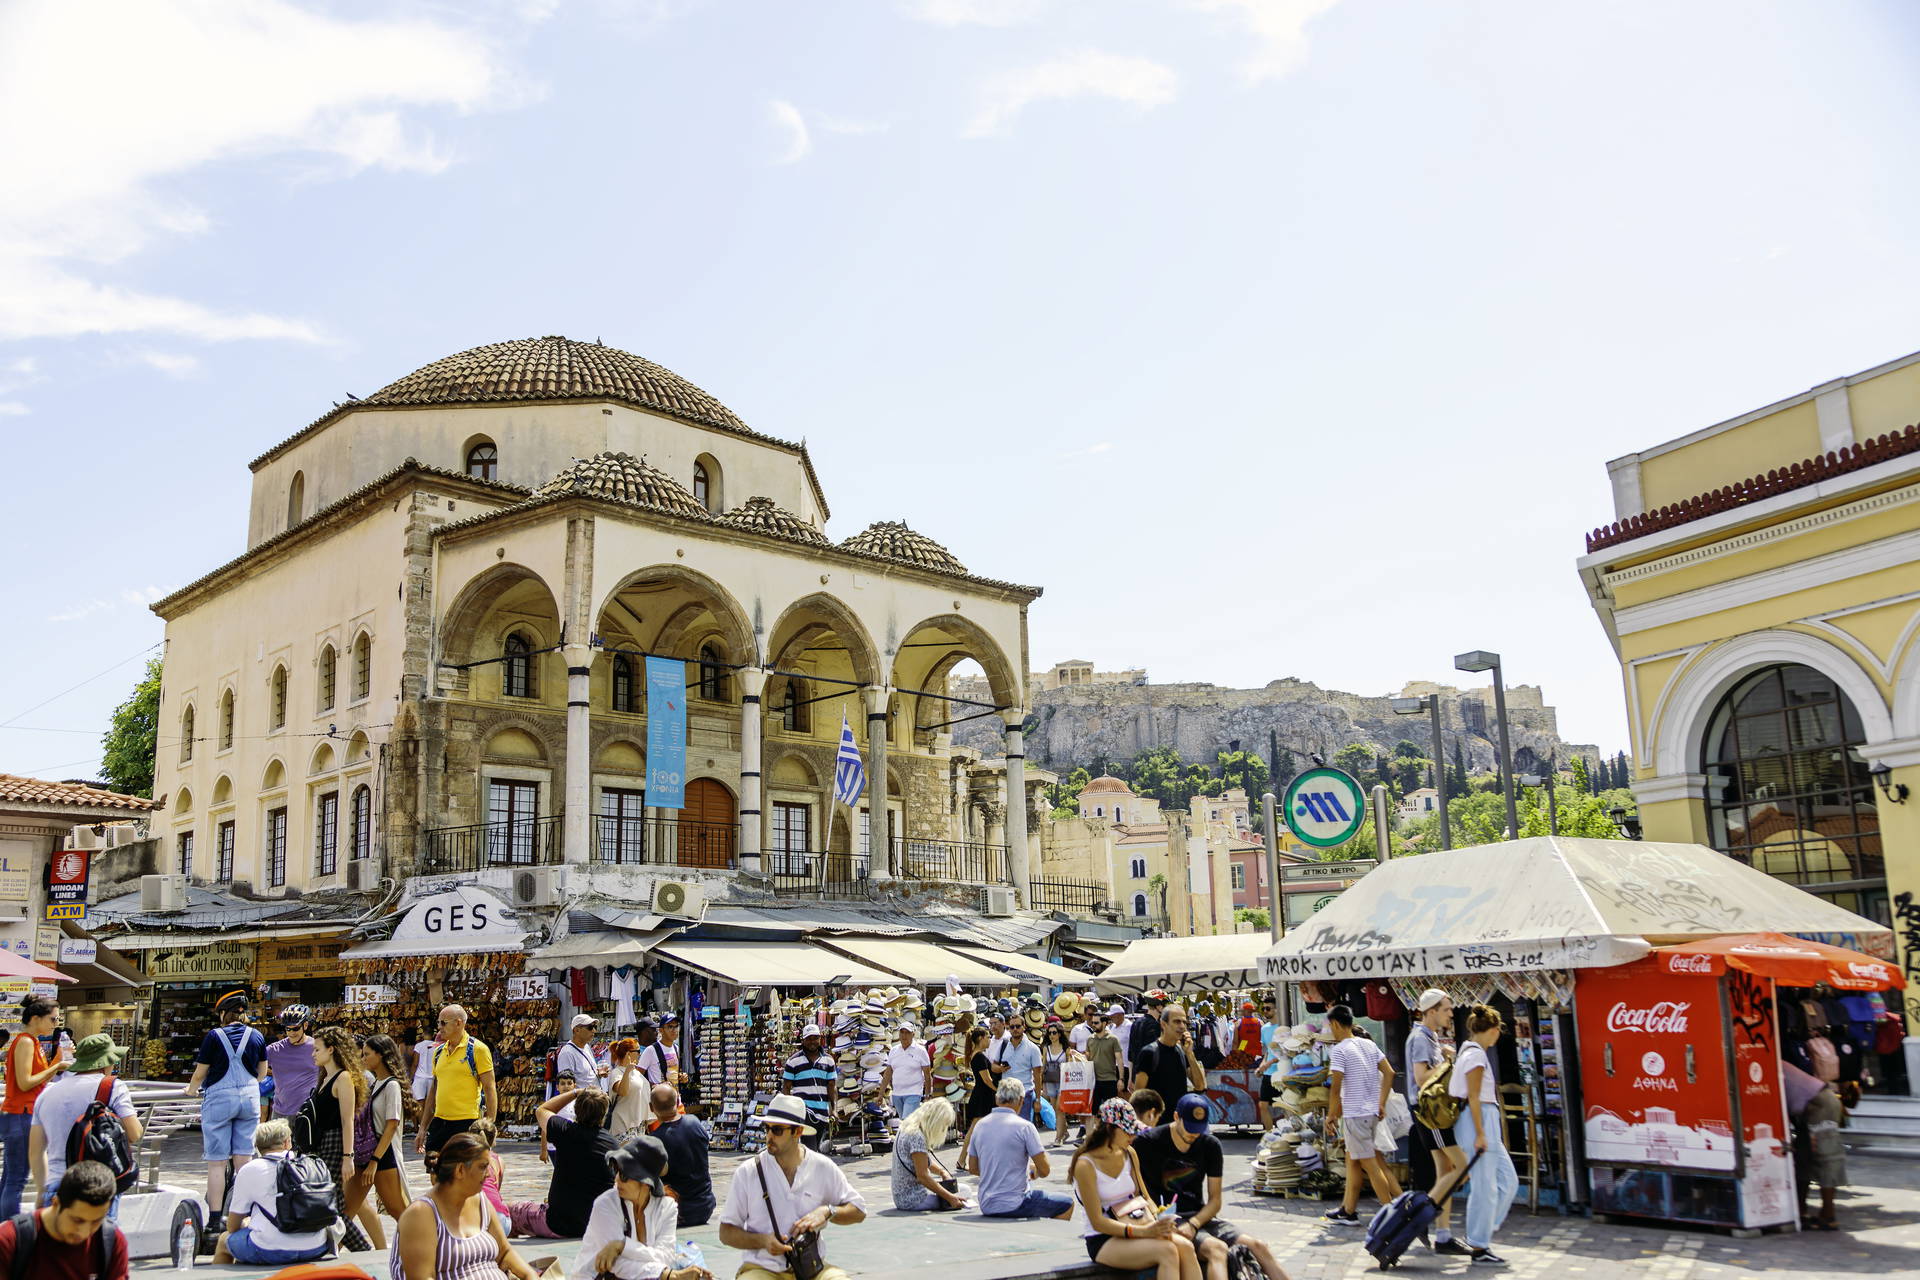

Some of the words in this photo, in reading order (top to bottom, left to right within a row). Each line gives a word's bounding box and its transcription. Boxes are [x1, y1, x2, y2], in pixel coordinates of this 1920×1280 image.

[50, 884, 84, 892] MINOAN
[55, 891, 77, 899] LINES
[51, 906, 81, 917] ATM
[424, 903, 488, 933] GES
[158, 960, 168, 973] in
[171, 957, 190, 972] the
[190, 957, 208, 972] old
[210, 957, 249, 973] mosque
[1607, 1001, 1692, 1033] Coca-Cola
[1632, 1077, 1679, 1092] ΑΘΗΝΑ
